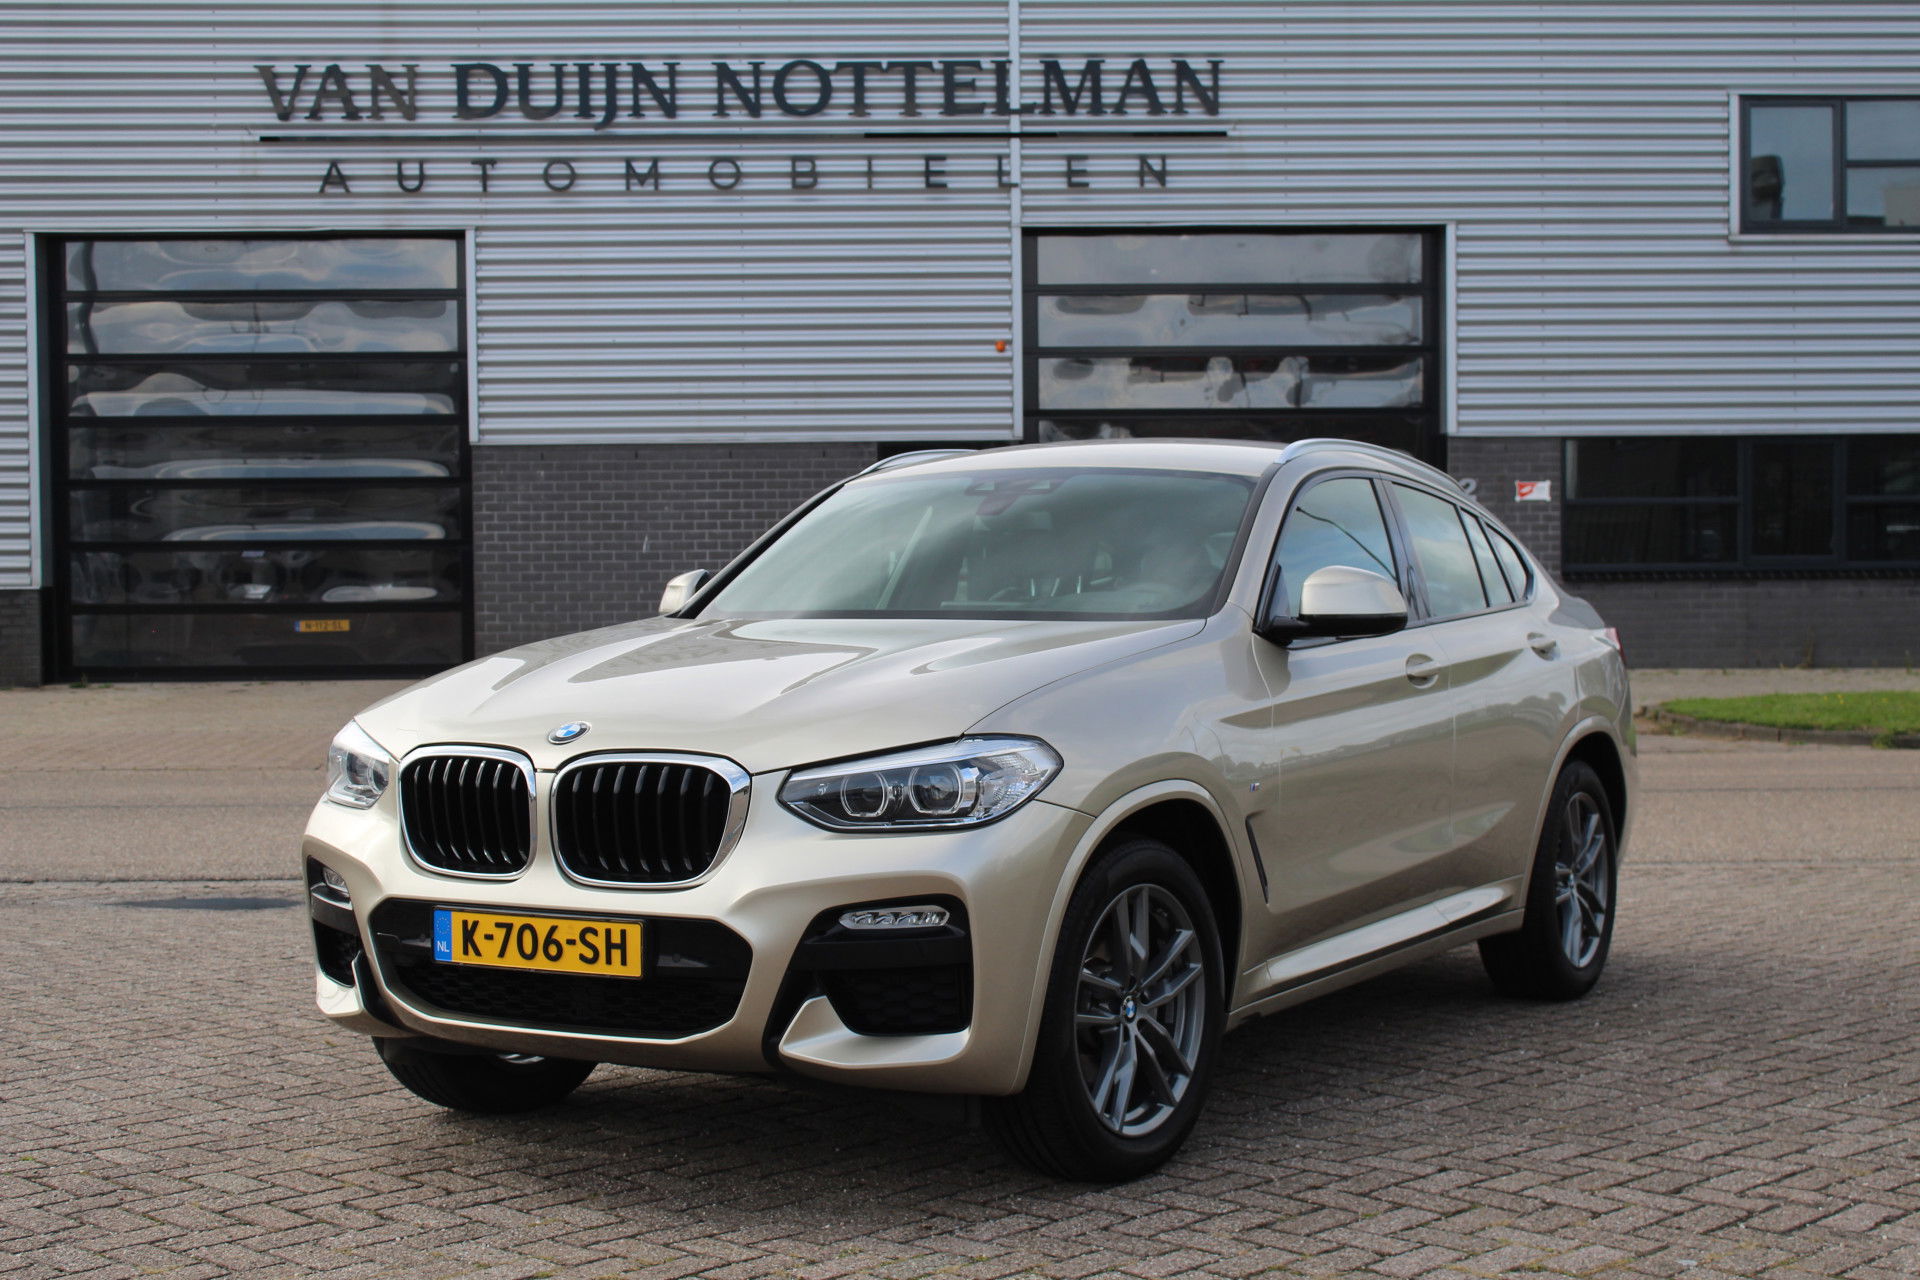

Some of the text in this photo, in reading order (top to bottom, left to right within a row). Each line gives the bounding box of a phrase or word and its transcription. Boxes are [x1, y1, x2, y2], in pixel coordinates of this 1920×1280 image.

[254, 58, 1224, 131] VAN DUIJN NOTTELMAN
[319, 155, 1168, 194] AUTOMOBIELEN
[437, 941, 449, 953] NL
[461, 919, 628, 967] K-706-SH
